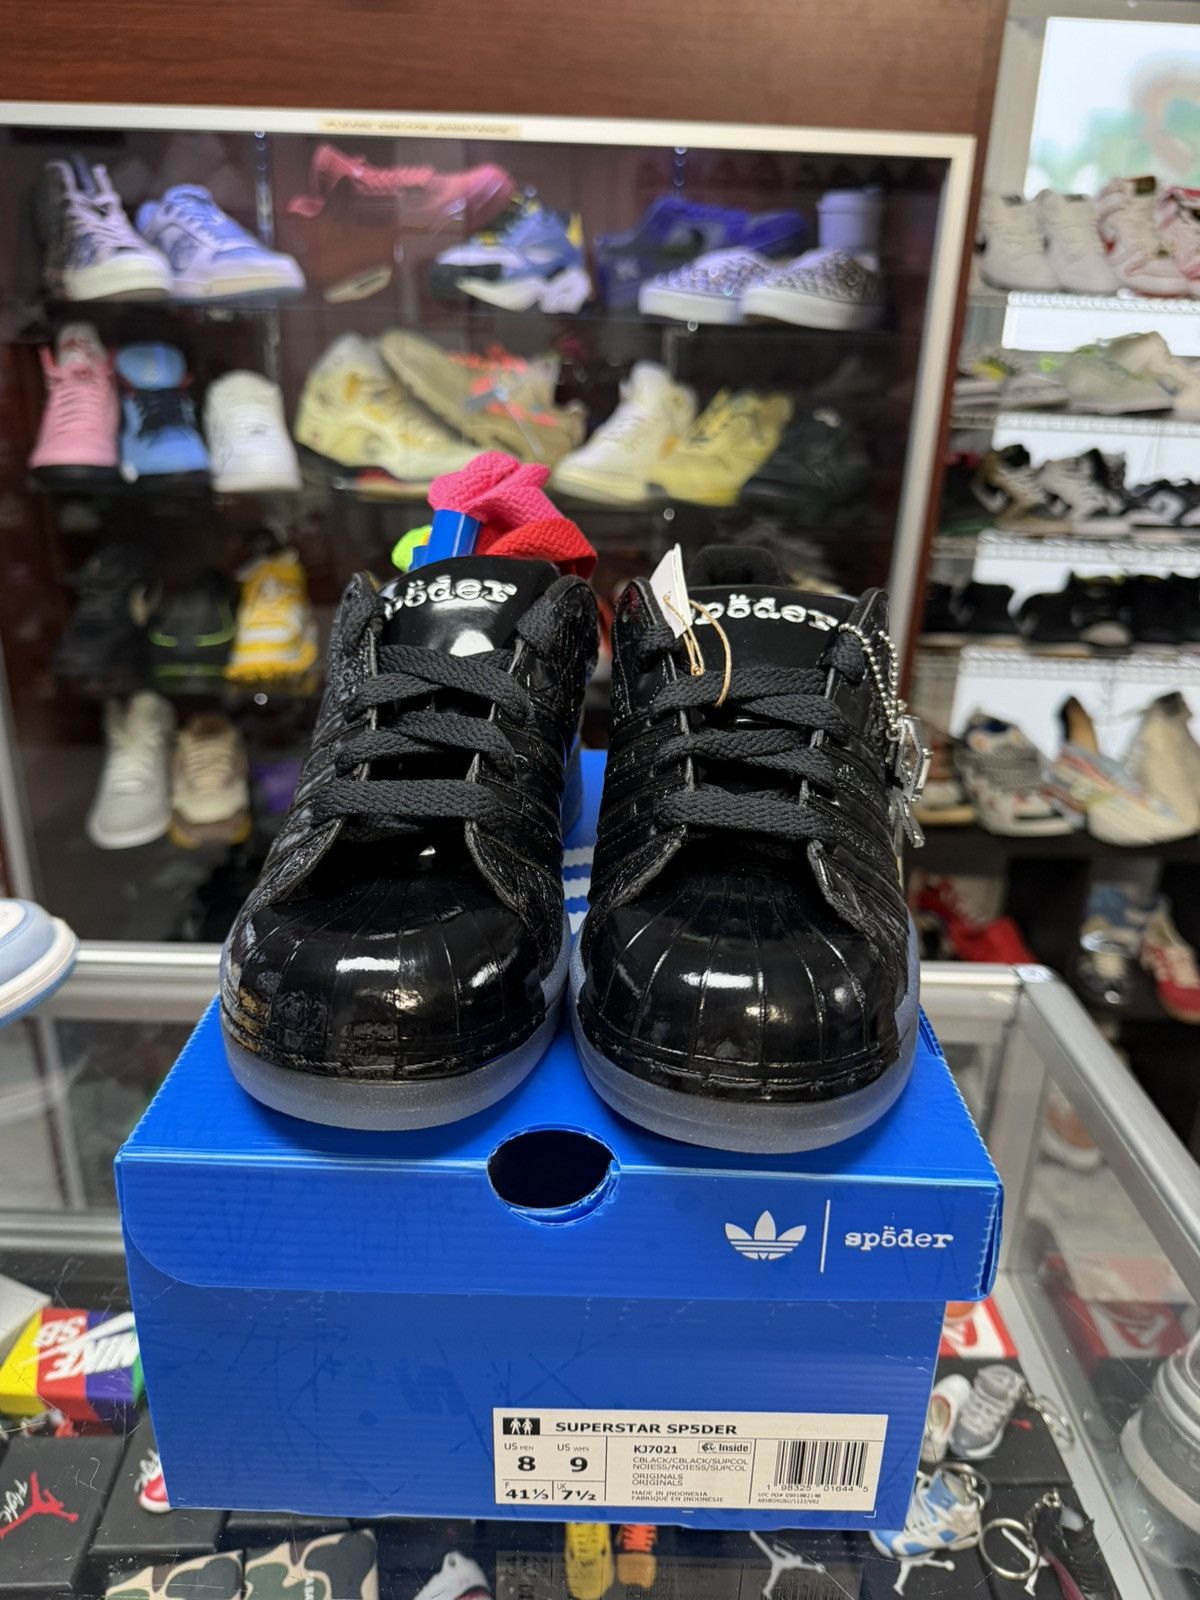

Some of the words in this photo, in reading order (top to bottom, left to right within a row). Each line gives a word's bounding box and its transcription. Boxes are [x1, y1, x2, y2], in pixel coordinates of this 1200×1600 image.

[555, 1422, 661, 1433] SUPERSTAR
[666, 1423, 738, 1435] SP5DER
[504, 1443, 518, 1451] US
[557, 1443, 571, 1452] US
[633, 1445, 677, 1454] KJ7021
[718, 1442, 749, 1452] Inside
[517, 1456, 536, 1472] 8
[570, 1457, 588, 1472] 9
[632, 1456, 749, 1465] CBLACK/CBLACK/SUPCOL
[632, 1464, 747, 1472] NOIESS/NOIESS/SUPCOL
